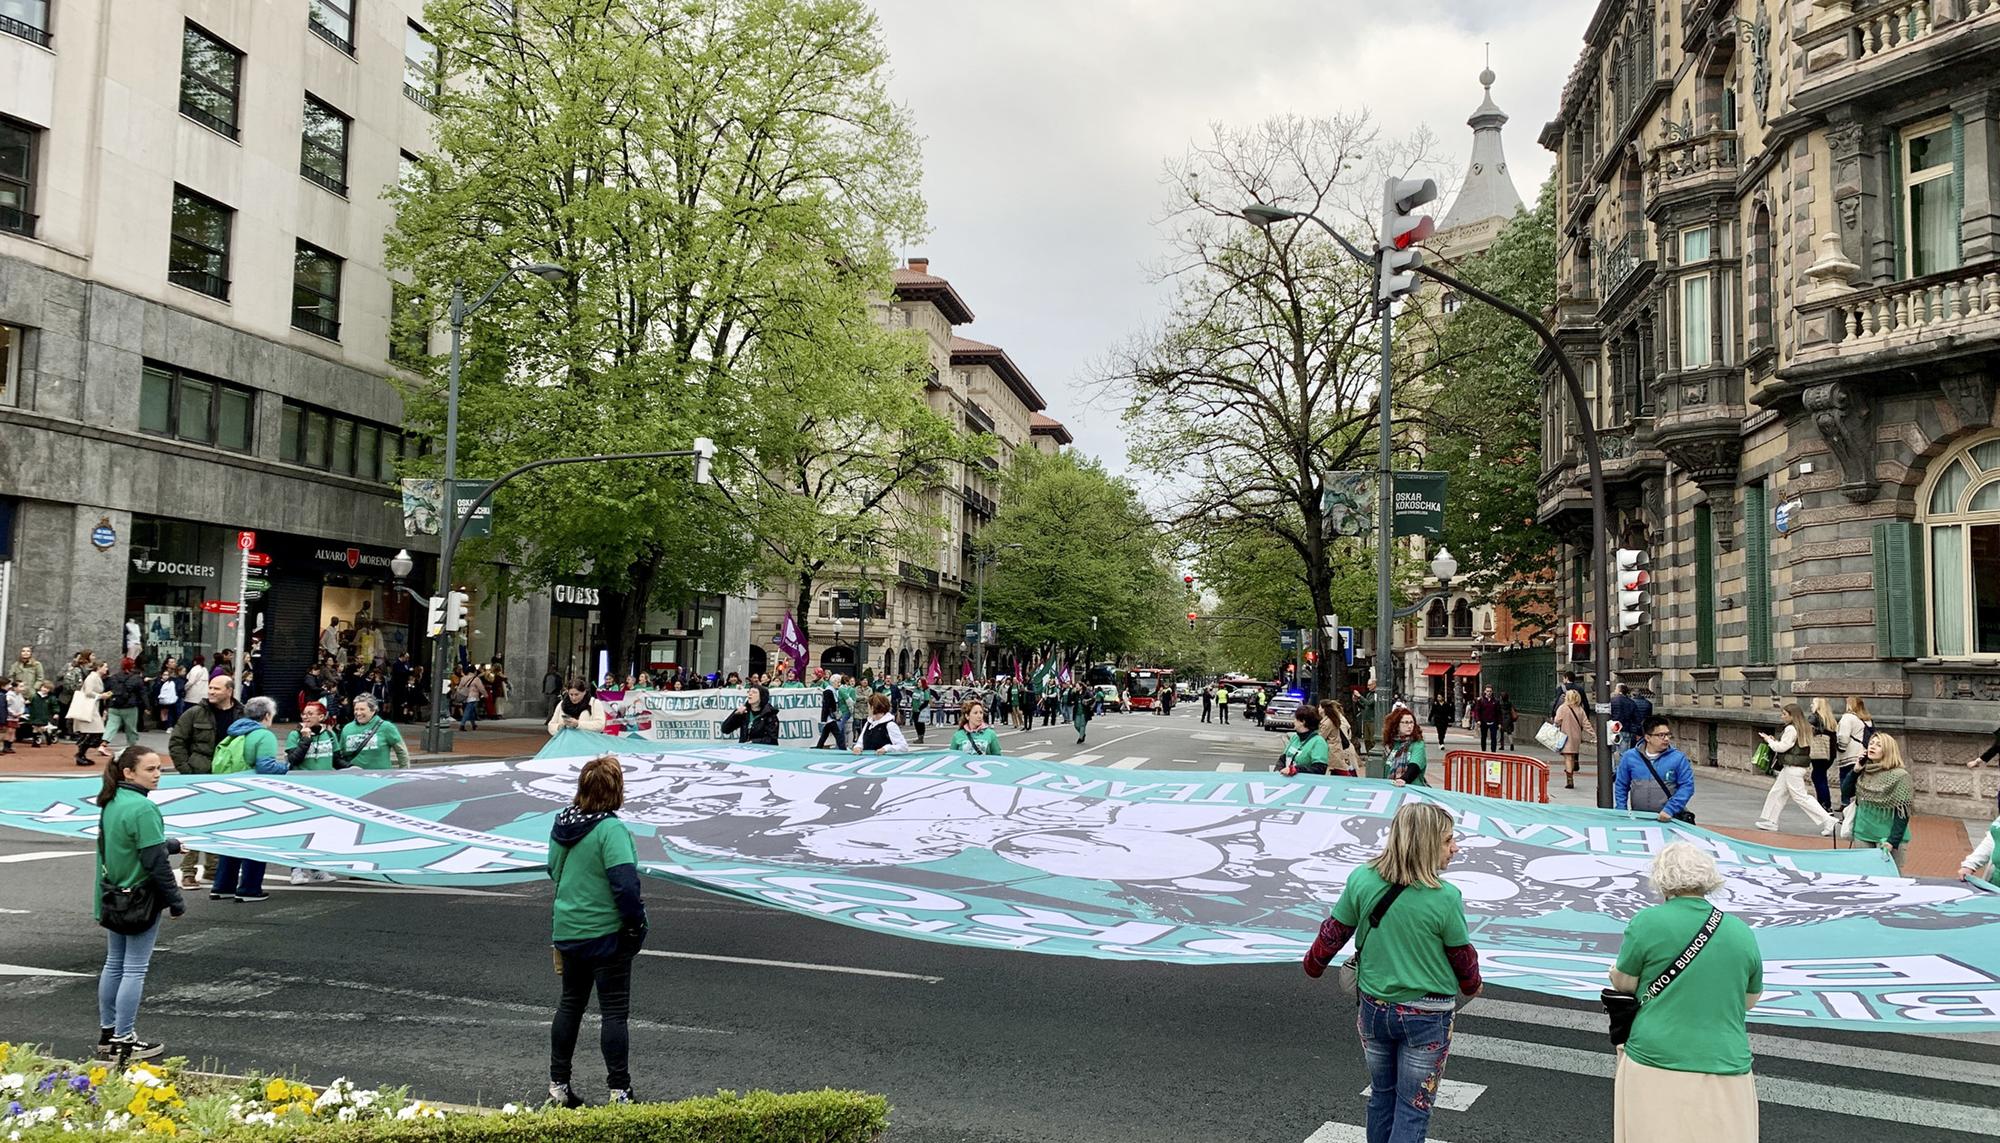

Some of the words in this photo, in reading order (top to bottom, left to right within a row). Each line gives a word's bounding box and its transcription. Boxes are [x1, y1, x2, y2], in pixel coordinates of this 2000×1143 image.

[1395, 492, 1422, 501] OSKAR
[1395, 502, 1441, 512] KOKOSCHKA
[315, 549, 347, 562] ALVARO
[360, 555, 391, 567] MORENO
[158, 561, 215, 577] DOCKERS
[554, 584, 600, 606] GUESS
[645, 696, 661, 710] GU
[666, 696, 699, 710] GABE
[702, 696, 718, 709] EZ
[671, 729, 710, 739] BIZKAIA
[807, 755, 1011, 781] STOP
[1675, 932, 1709, 970] BUENOS
[1705, 909, 1723, 934] AIRES
